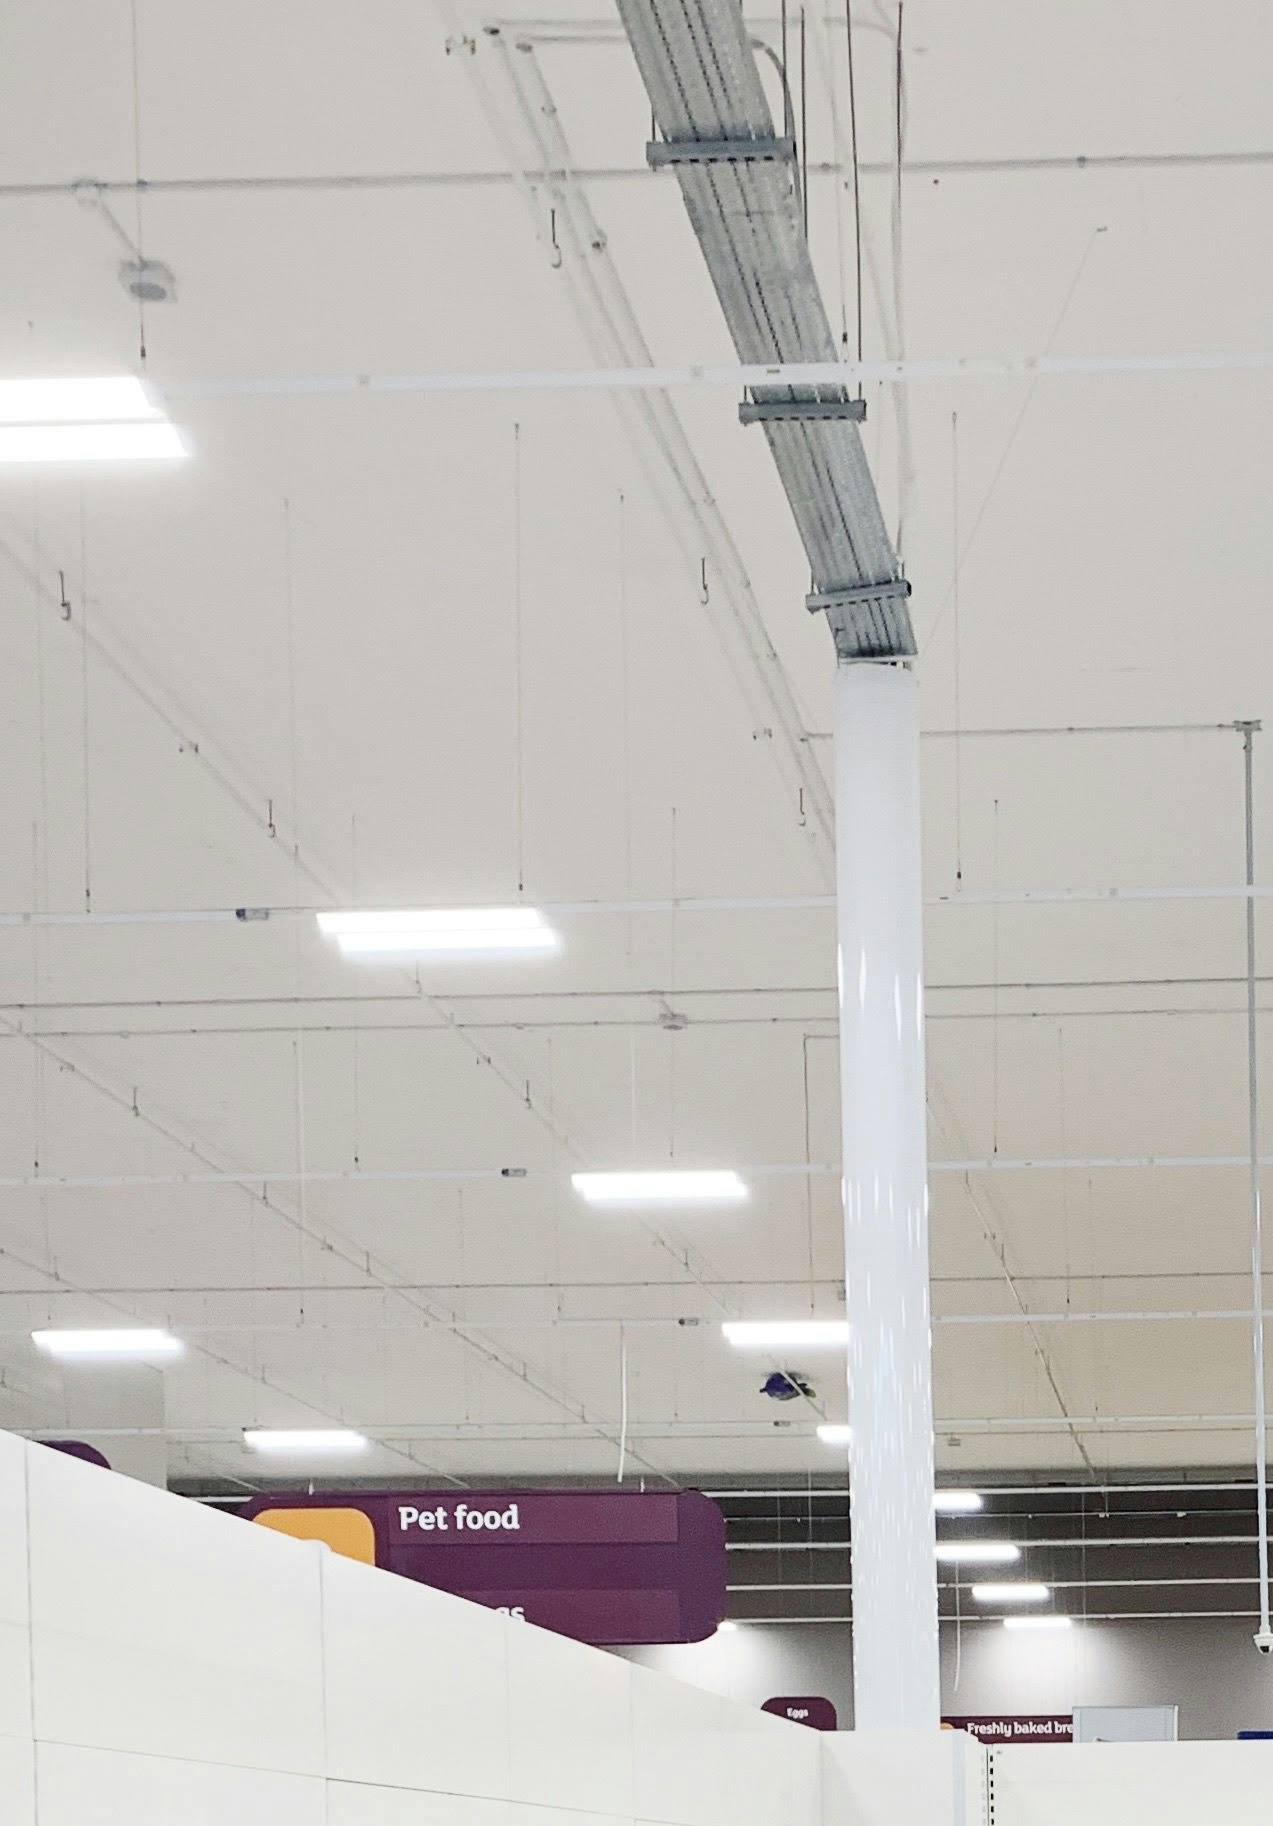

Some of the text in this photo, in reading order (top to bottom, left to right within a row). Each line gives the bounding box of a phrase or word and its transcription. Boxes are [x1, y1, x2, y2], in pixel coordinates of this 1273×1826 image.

[399, 1504, 520, 1530] Pet food
[787, 1707, 808, 1718] Eggs
[967, 1722, 1011, 1738] Freshly
[1014, 1721, 1052, 1734] baked
